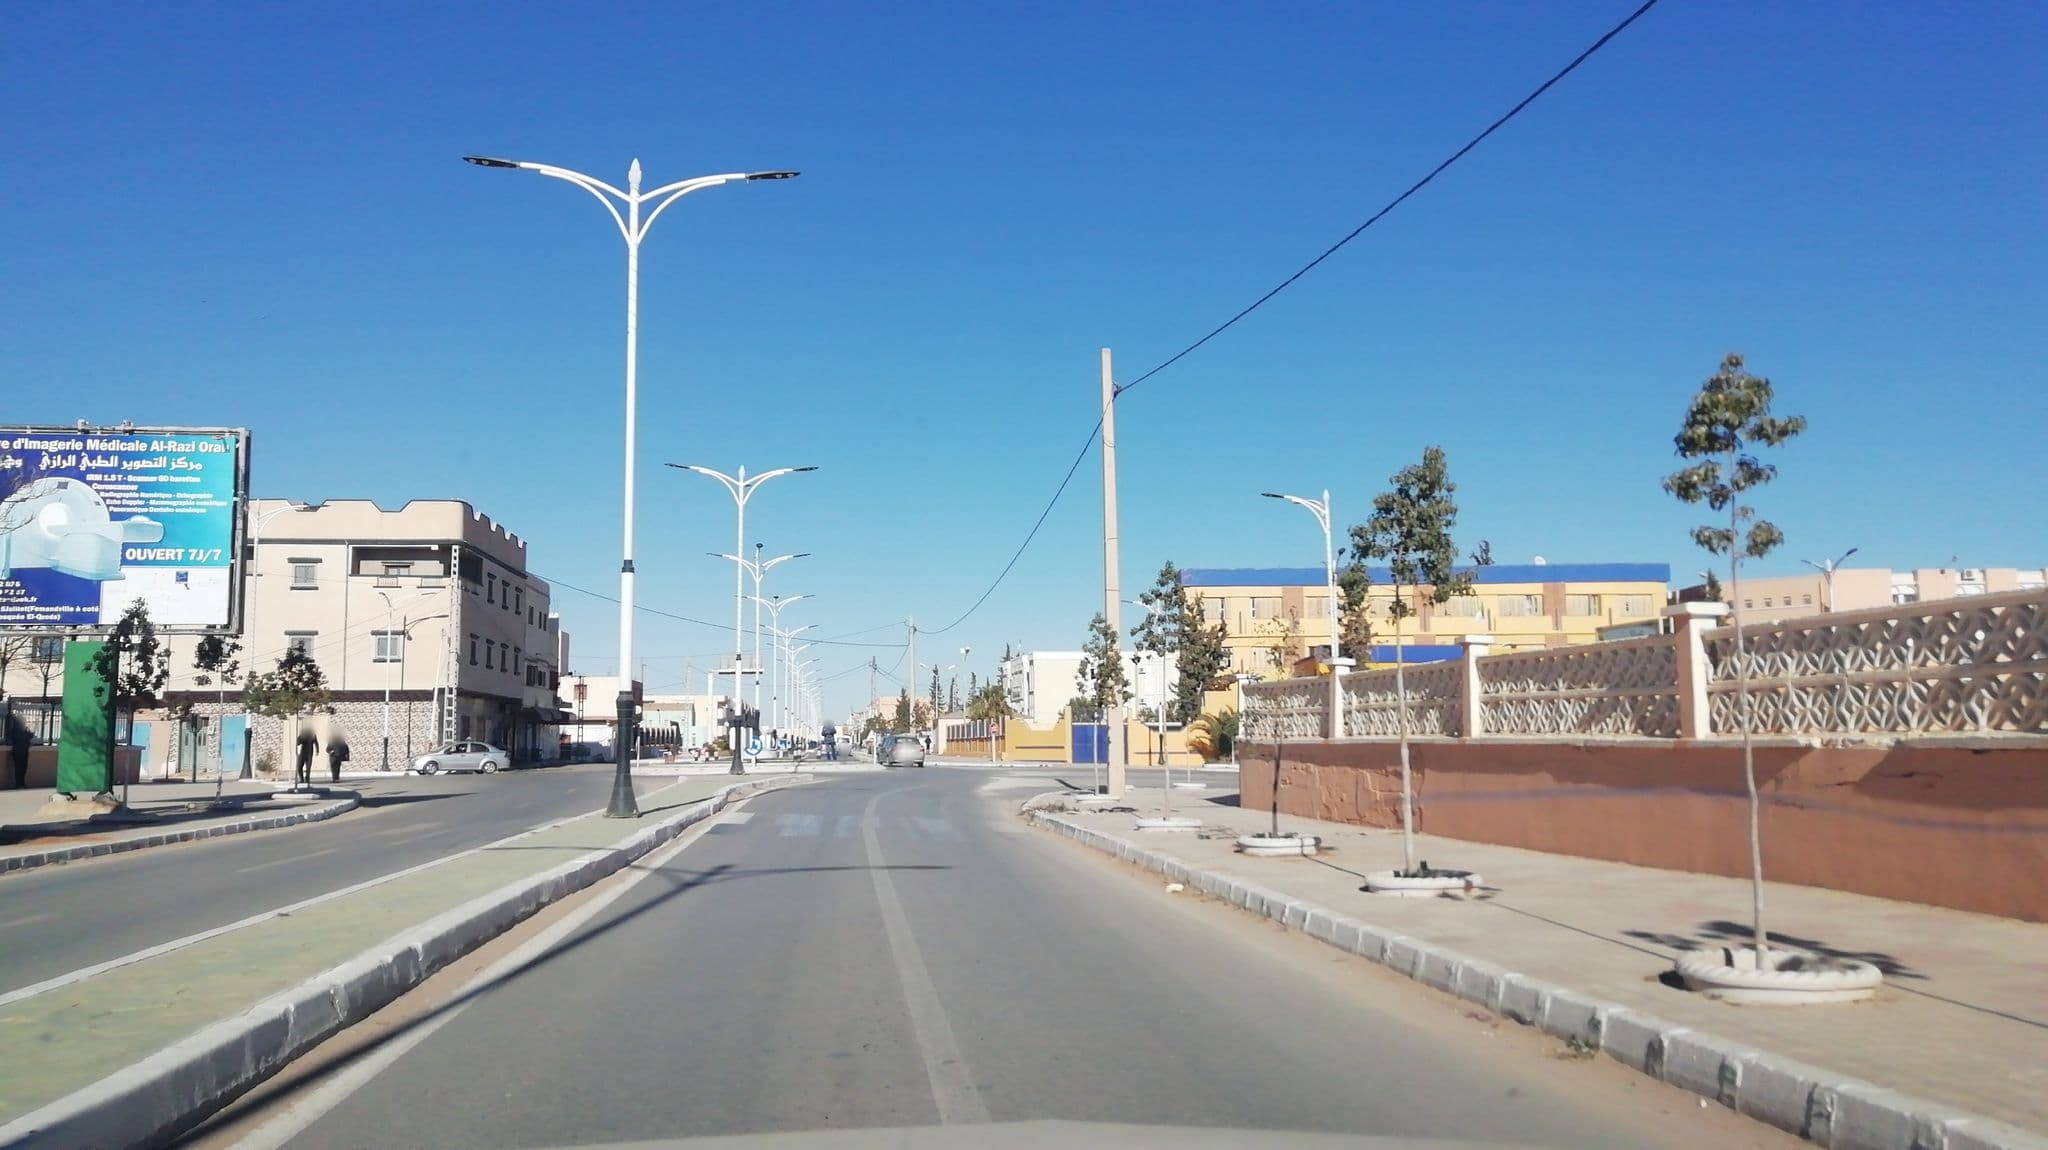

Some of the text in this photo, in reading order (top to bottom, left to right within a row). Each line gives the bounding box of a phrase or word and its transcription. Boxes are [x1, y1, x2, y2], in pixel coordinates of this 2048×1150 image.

[13, 438, 83, 452] d'Imagerie
[86, 439, 148, 451] Médicale
[150, 440, 196, 452] Al-Razi
[38, 451, 76, 470] الرازي
[78, 452, 118, 471] الطبي
[120, 456, 167, 470] التصوير
[170, 456, 203, 470] مركز
[125, 548, 186, 561] OUVERT
